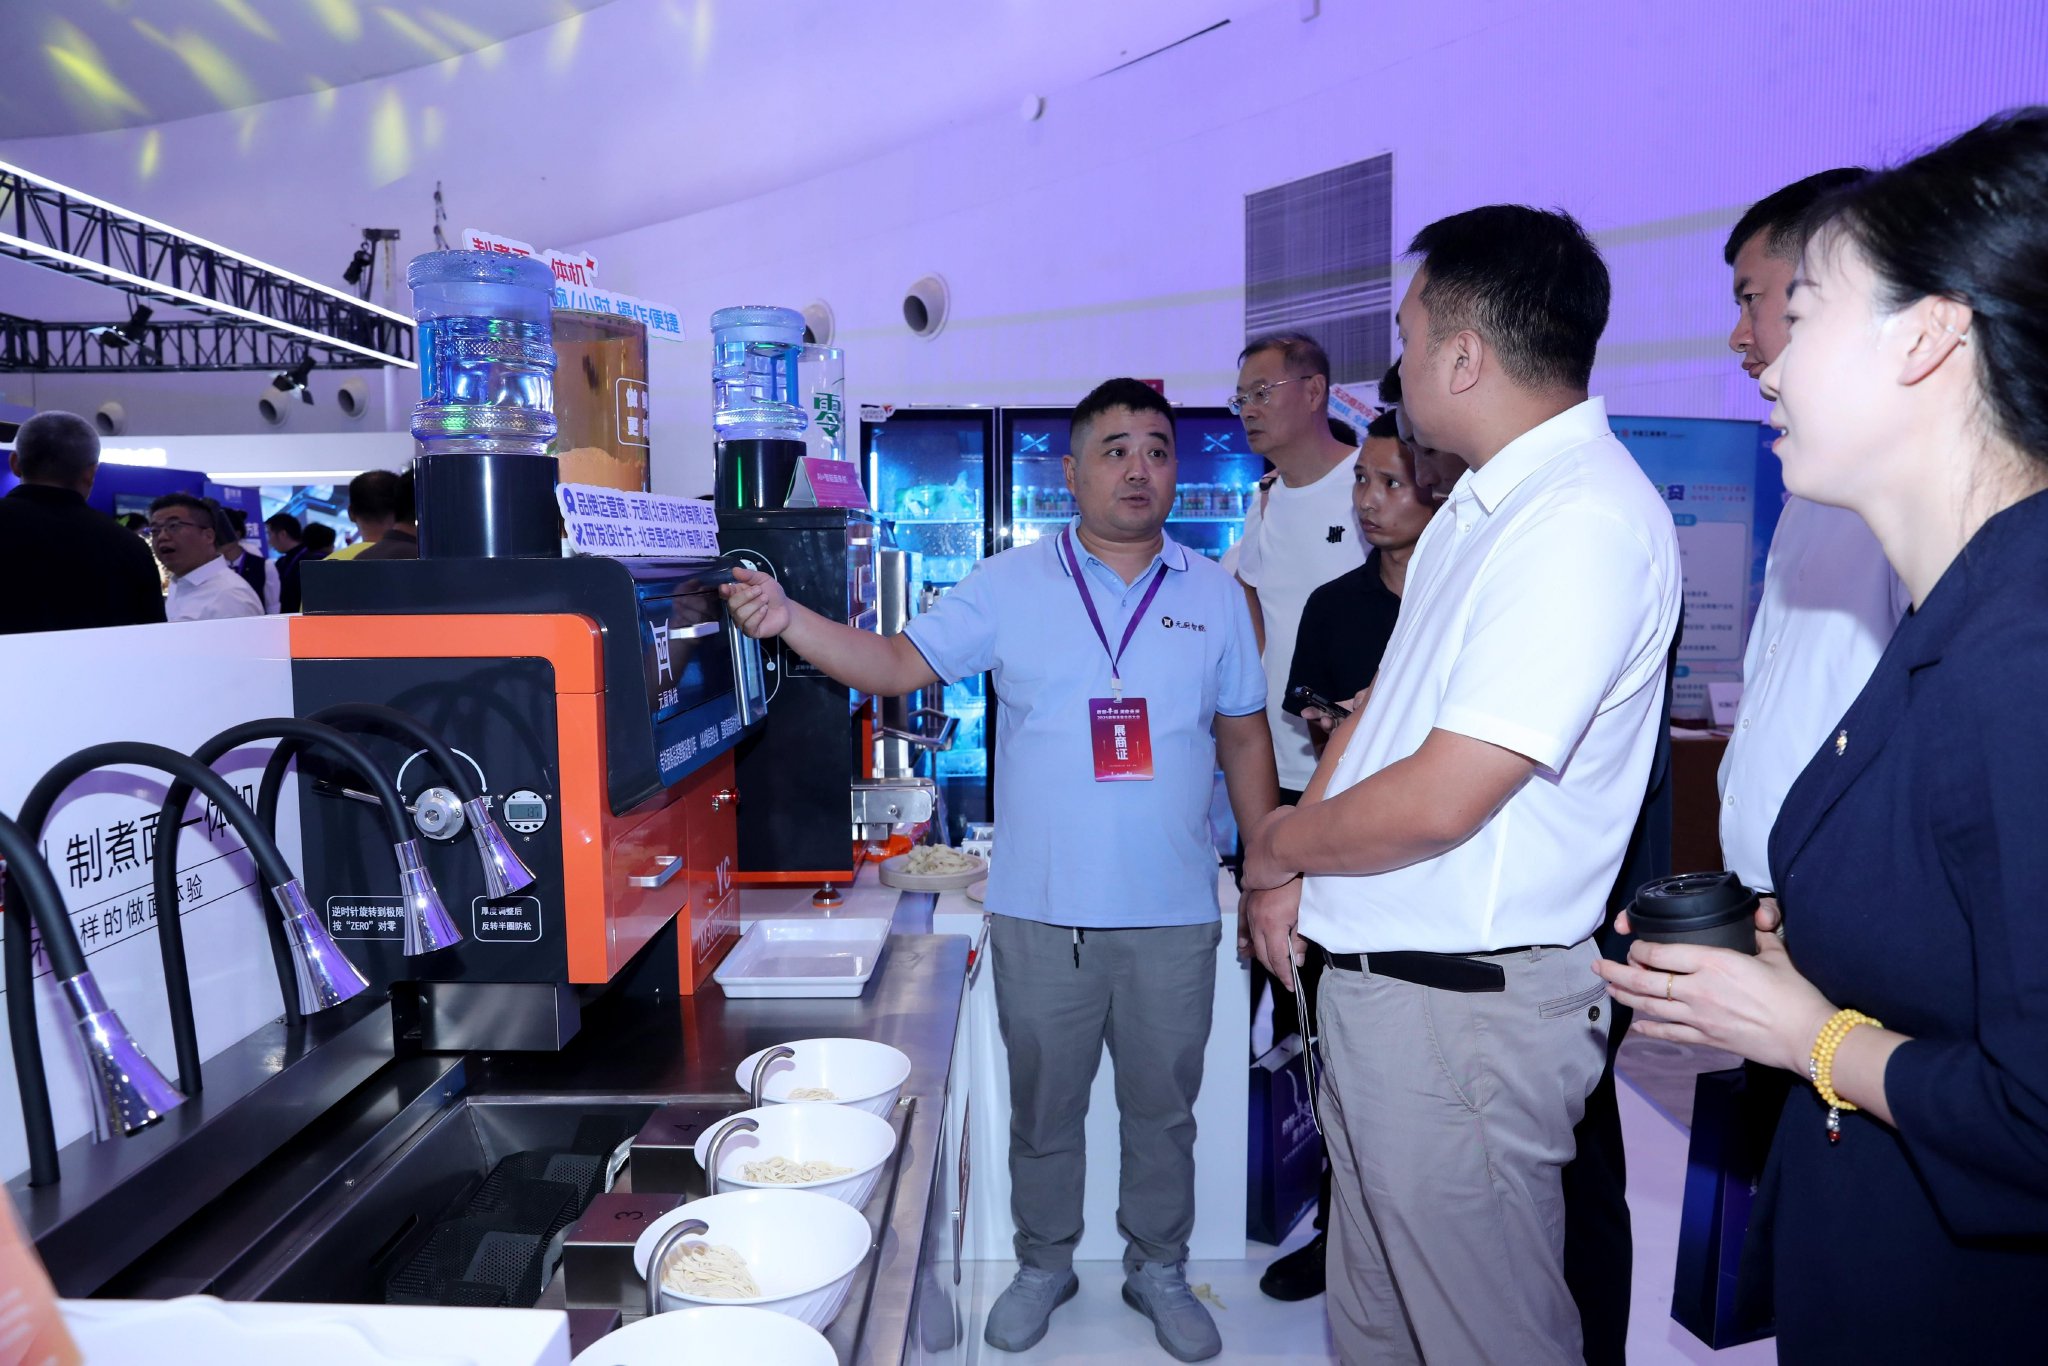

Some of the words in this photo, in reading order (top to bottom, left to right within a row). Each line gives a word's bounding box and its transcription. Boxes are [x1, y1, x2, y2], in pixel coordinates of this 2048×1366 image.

[1114, 724, 1129, 760] 展商证
[715, 855, 731, 897] YC
[481, 906, 523, 916] 厚度调整后
[481, 921, 532, 932] 反转半圈防松
[615, 1211, 644, 1221] 3
